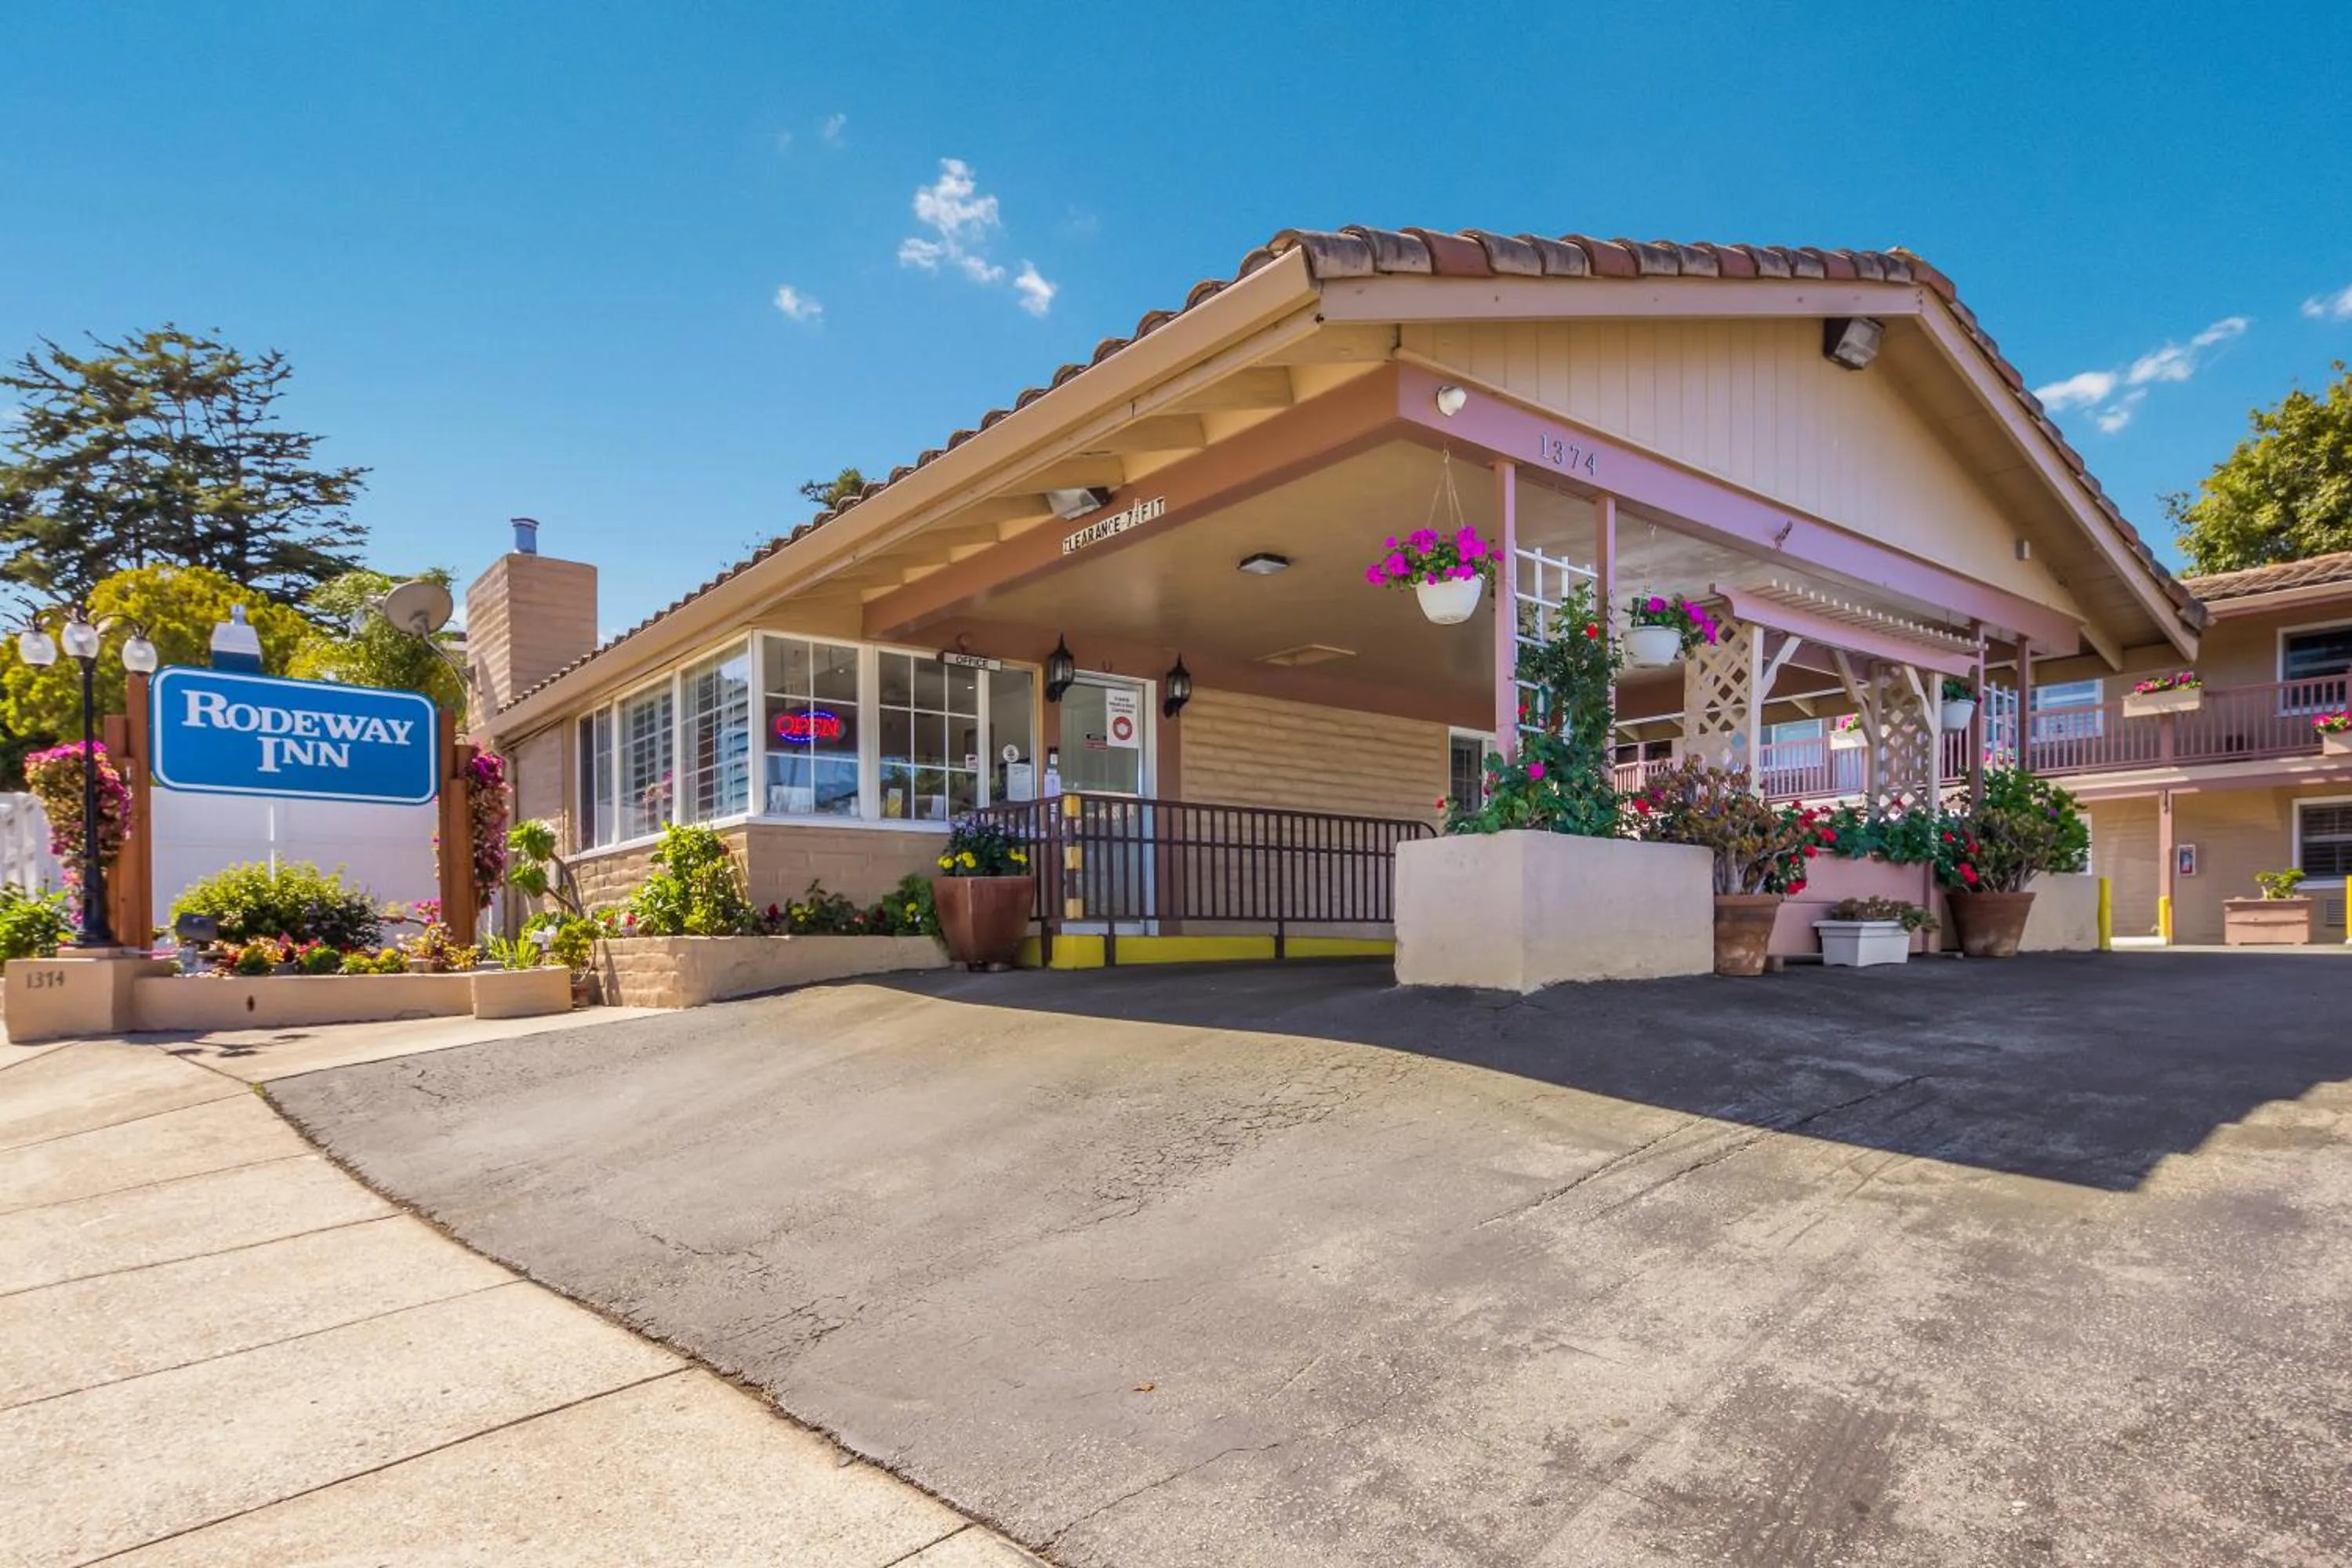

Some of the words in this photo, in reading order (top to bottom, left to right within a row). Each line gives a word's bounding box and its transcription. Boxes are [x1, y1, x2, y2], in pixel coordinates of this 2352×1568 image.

[1540, 434, 1595, 477] 1374
[1062, 515, 1120, 554] CLEARANCE
[956, 654, 989, 669] OFFICE
[181, 689, 414, 746] RODEWAY
[776, 715, 839, 740] OPEN
[256, 736, 350, 772] INN
[26, 971, 64, 989] 1374
